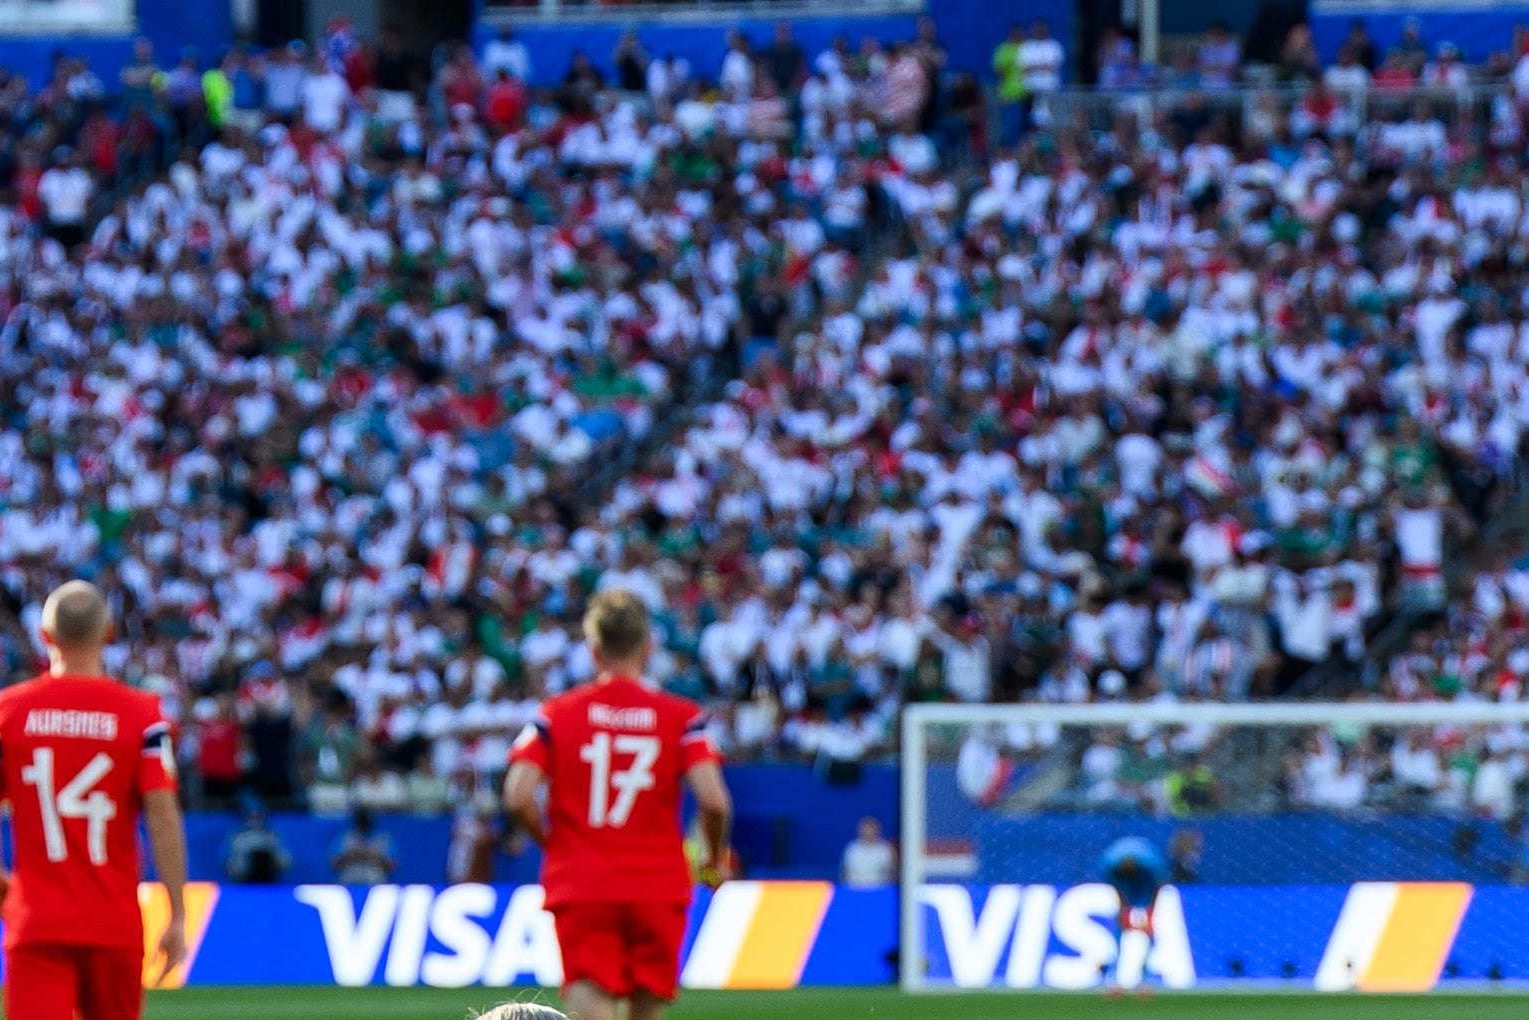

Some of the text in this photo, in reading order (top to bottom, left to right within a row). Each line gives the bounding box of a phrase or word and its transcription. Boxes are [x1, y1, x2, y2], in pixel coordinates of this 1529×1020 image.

[21, 746, 117, 866] 14
[579, 731, 661, 828] 17
[294, 883, 566, 987] VISA
